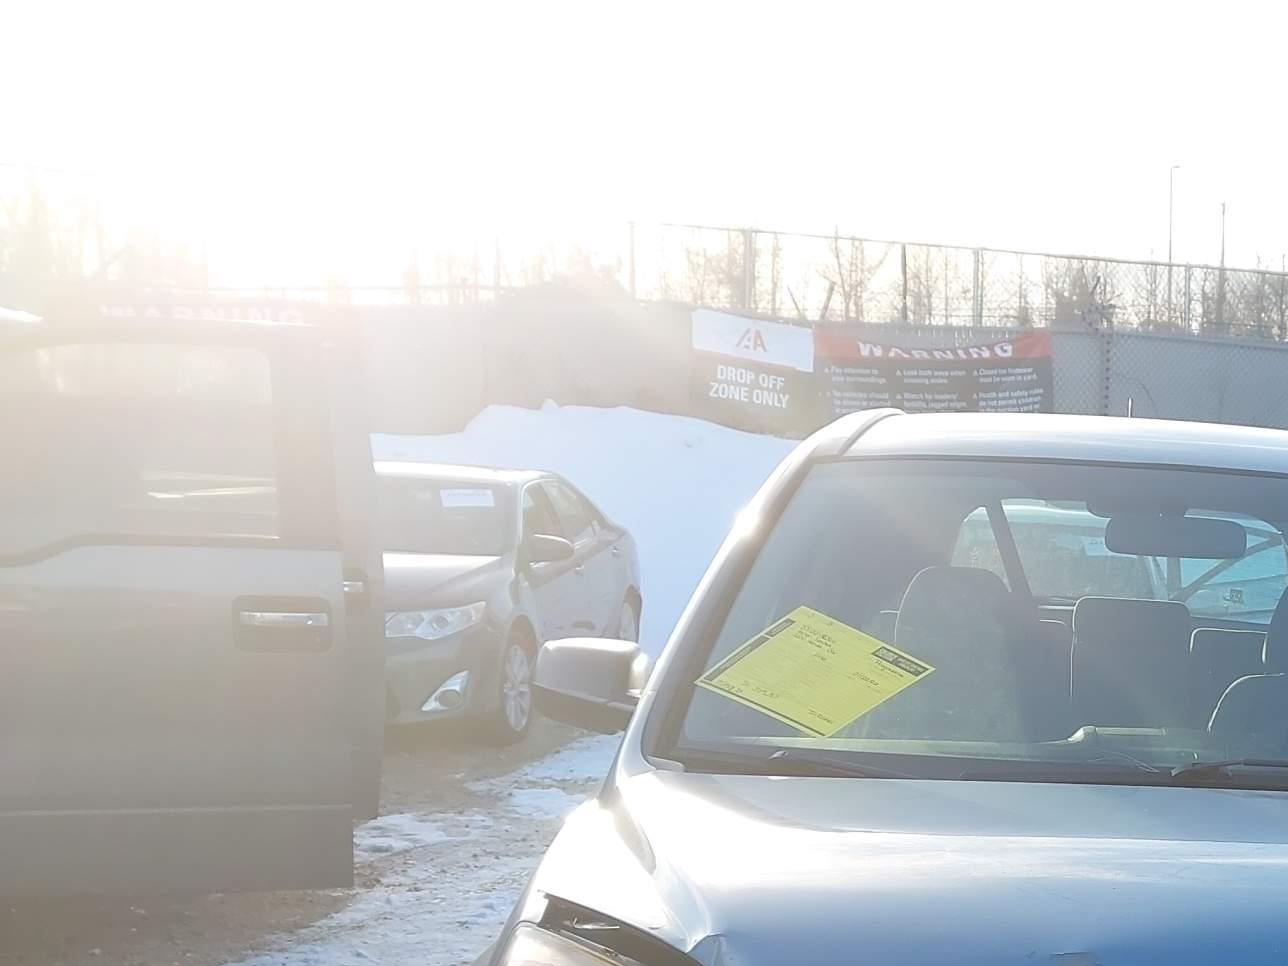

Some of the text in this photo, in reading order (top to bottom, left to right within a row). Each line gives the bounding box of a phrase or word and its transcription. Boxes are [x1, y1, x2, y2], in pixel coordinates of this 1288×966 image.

[857, 341, 1013, 359] WARNING
[717, 365, 785, 389] DROP OFF
[709, 382, 789, 409] ZONE ONLY
